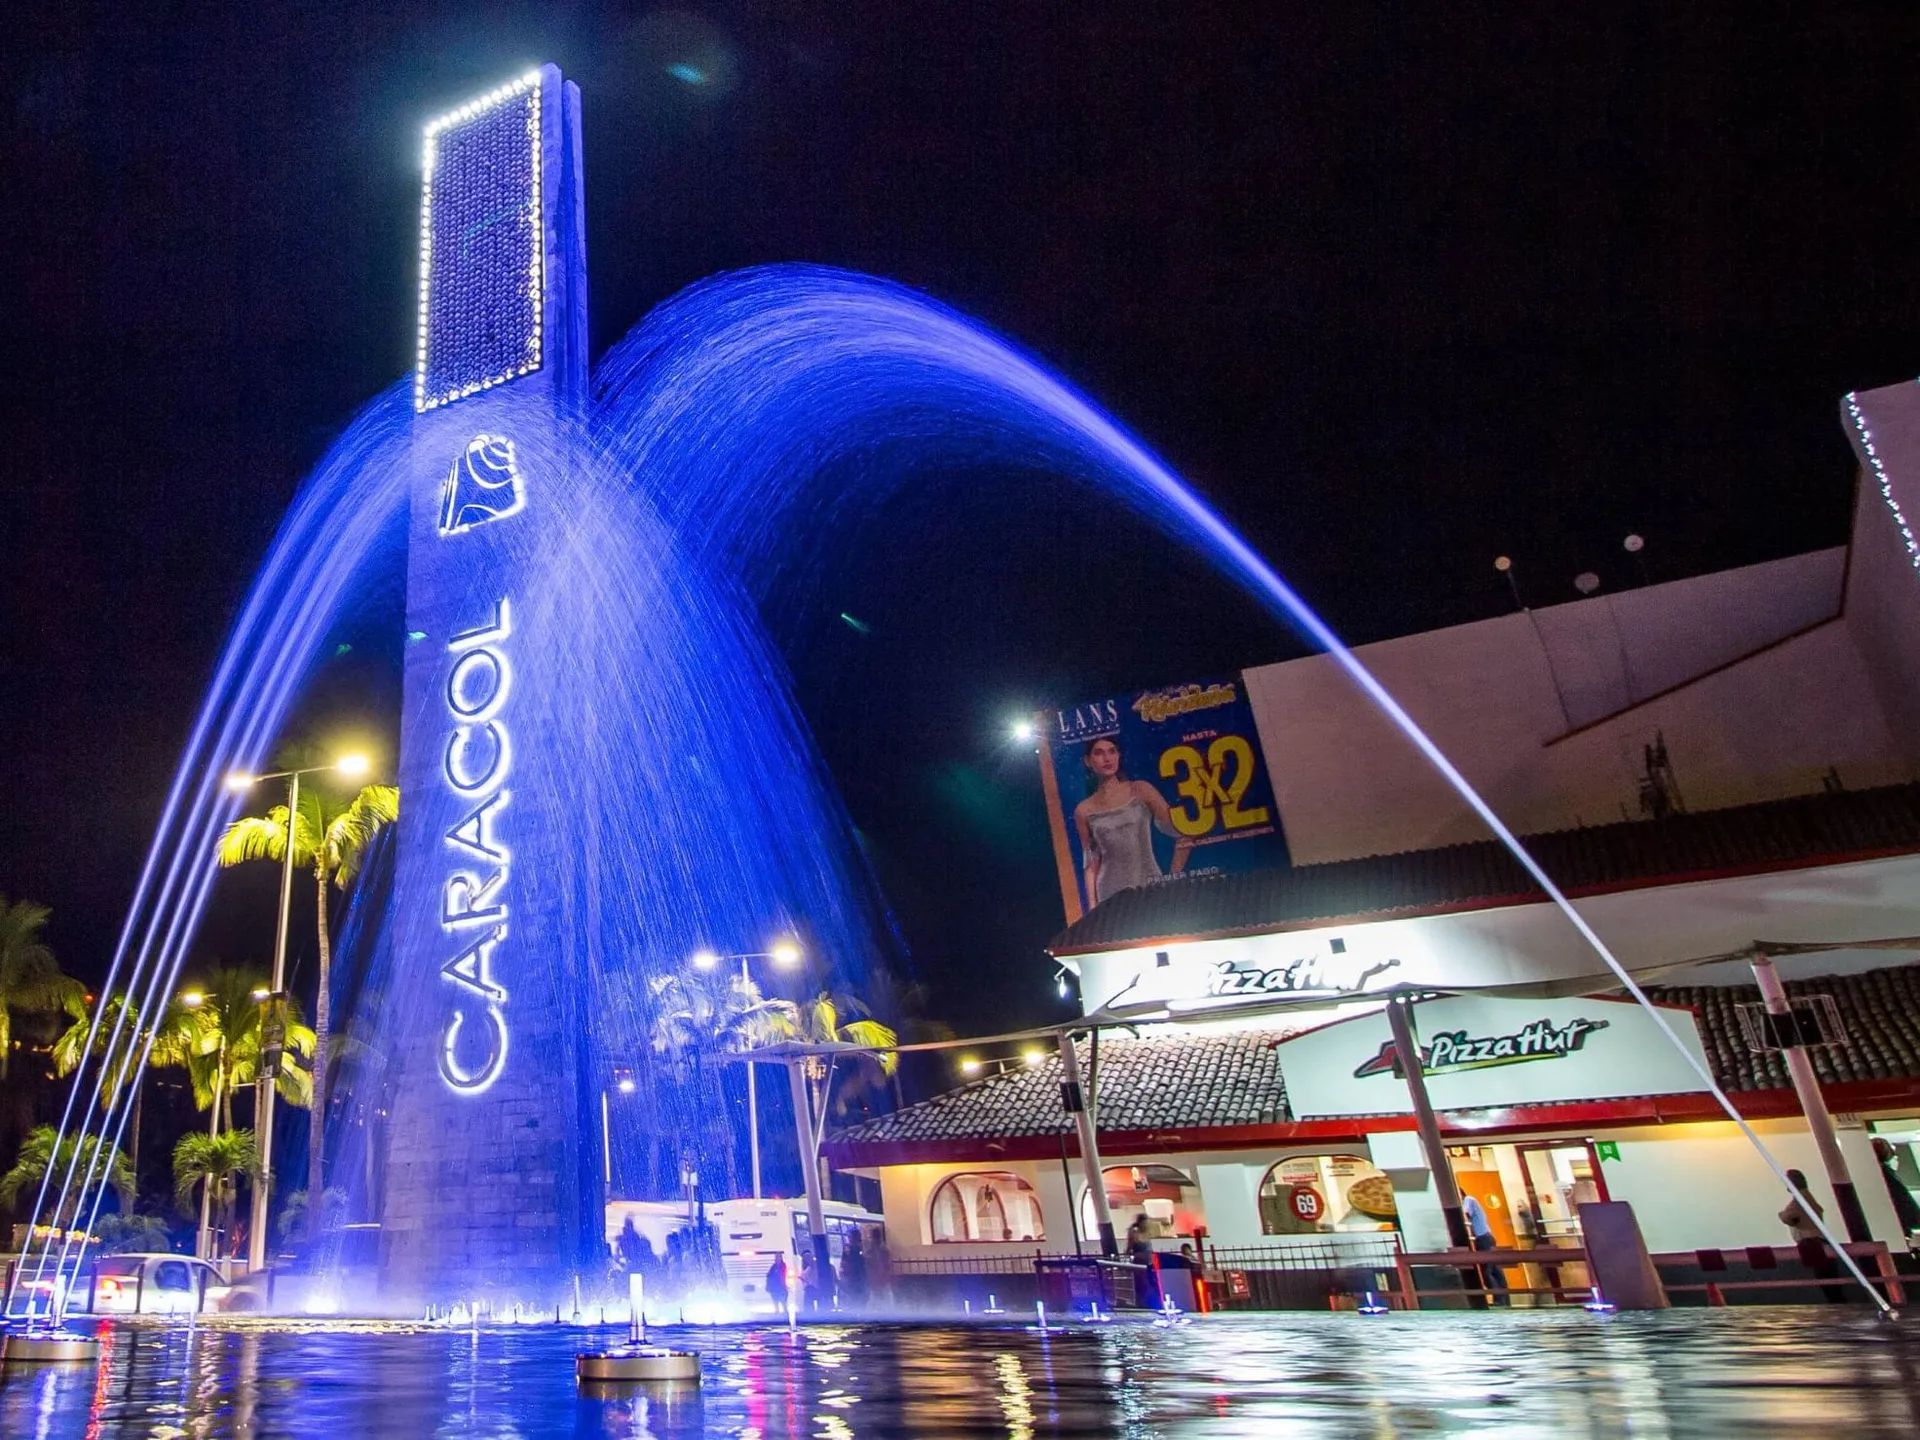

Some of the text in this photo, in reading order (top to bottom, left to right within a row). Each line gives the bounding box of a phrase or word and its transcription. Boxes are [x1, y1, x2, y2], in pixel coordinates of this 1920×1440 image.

[1057, 700, 1119, 733] LANS
[1182, 729, 1217, 742] HASTA
[439, 597, 510, 1094] CARACOL
[1203, 960, 1289, 997] Pizza
[1429, 1021, 1589, 1069] Pizza Hut
[1295, 1194, 1318, 1214] 69
